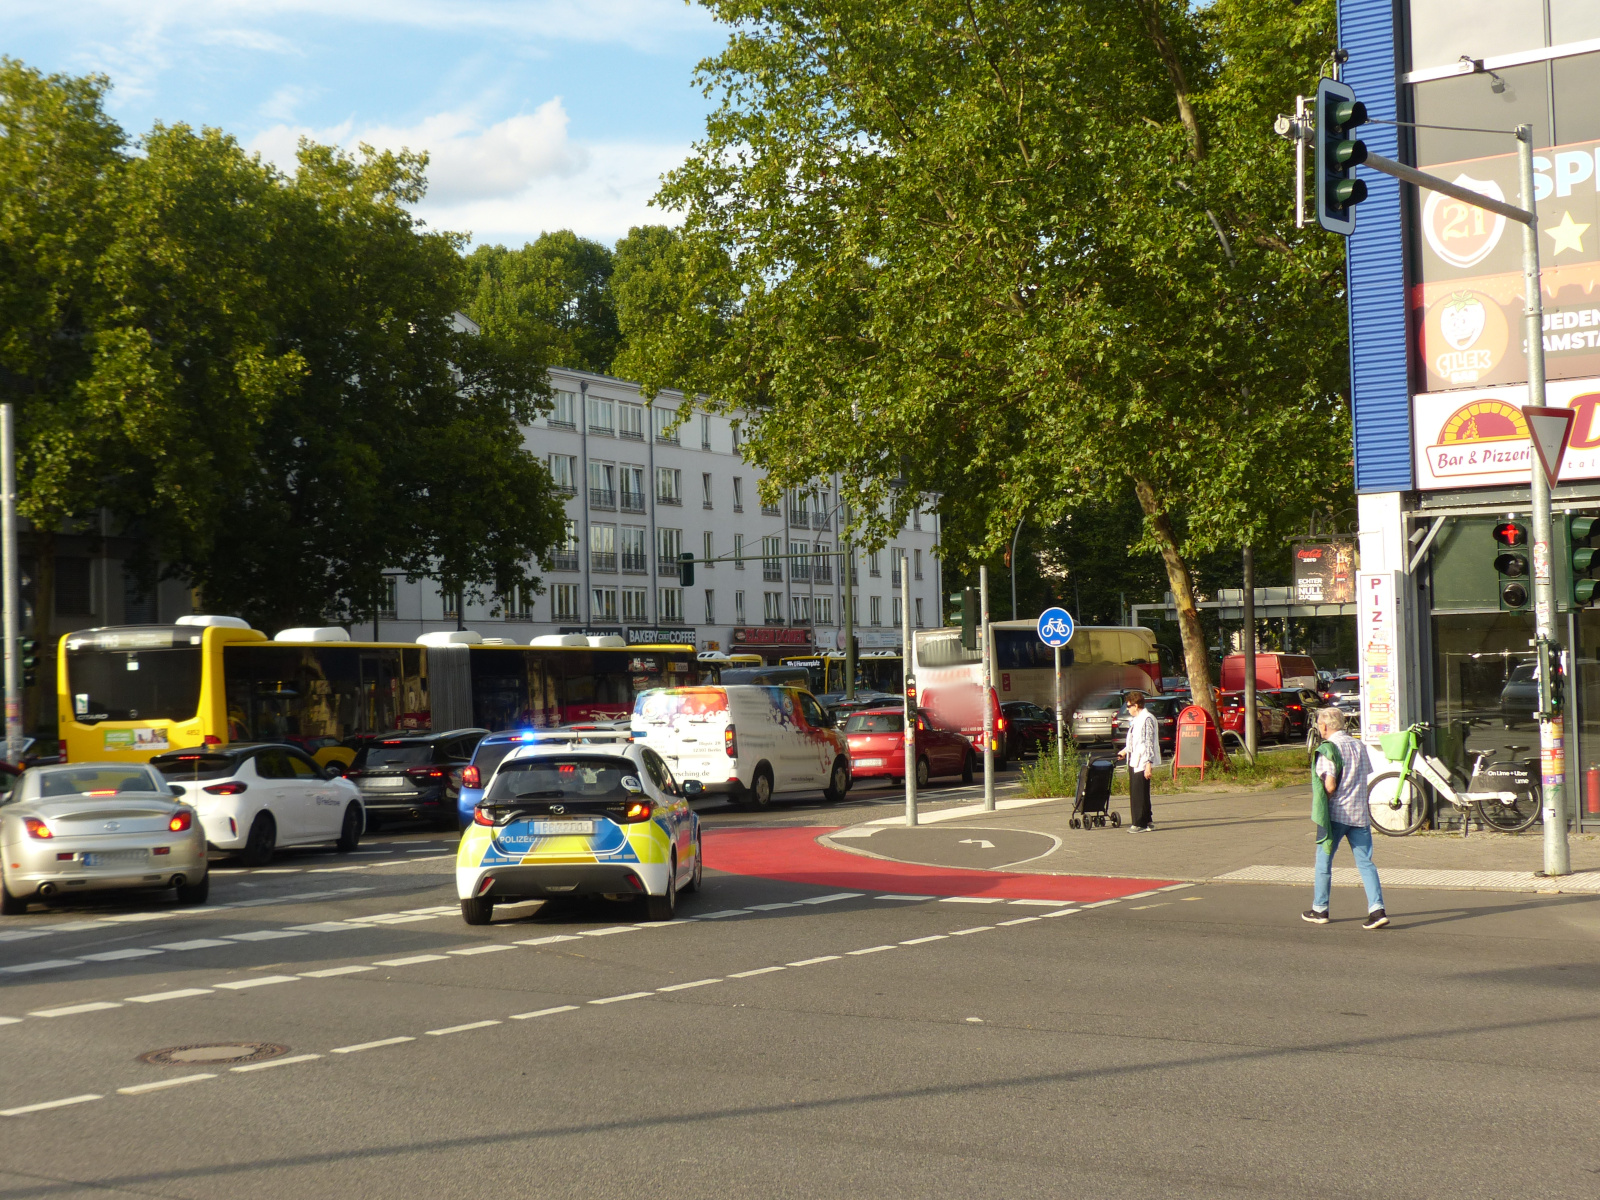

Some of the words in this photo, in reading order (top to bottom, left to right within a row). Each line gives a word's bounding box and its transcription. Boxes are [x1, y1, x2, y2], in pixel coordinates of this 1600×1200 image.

[1517, 146, 1600, 202] SP
[1442, 203, 1486, 242] 21
[1438, 454, 1463, 468] Bar
[1468, 450, 1477, 464] &
[1482, 446, 1532, 463] Pizzeri
[1298, 587, 1322, 595] NULL
[629, 630, 659, 643] BAKERY
[670, 631, 696, 643] COFFEE
[500, 836, 537, 844] POLIZE
